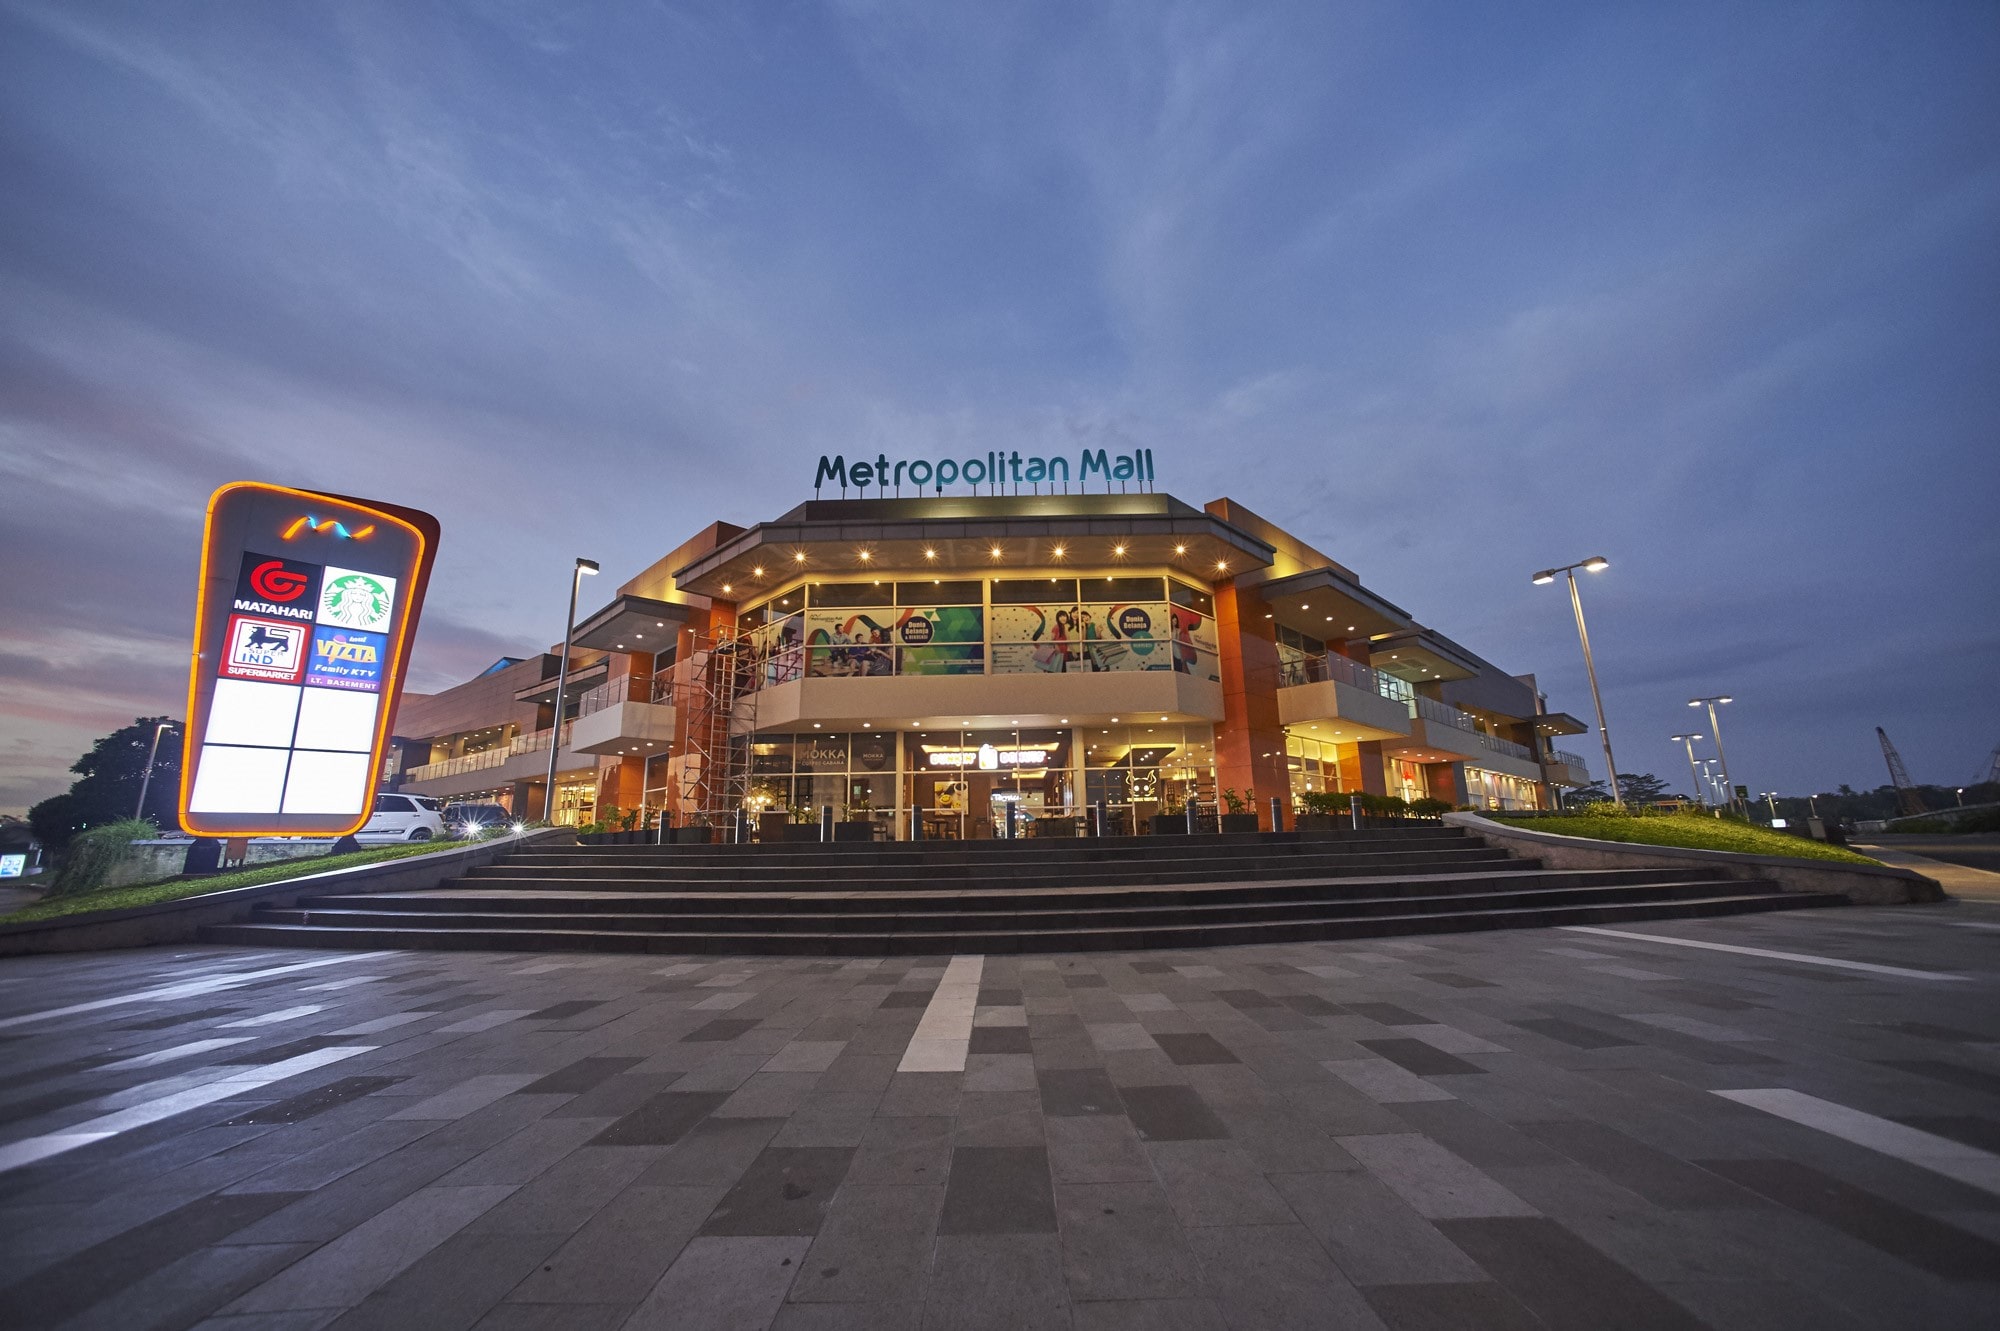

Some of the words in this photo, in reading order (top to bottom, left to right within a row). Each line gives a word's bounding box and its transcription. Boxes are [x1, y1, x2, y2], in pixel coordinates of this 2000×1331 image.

[814, 451, 1069, 492] Metropolitan
[1080, 448, 1154, 481] Mall
[234, 600, 313, 620] MATAHARI
[248, 648, 284, 657] SUPER
[228, 667, 297, 681] SUPERMARKET
[315, 664, 350, 676] Family
[350, 667, 376, 678] KTV
[310, 677, 323, 685] LT.
[327, 679, 376, 690] BASEMENT
[801, 749, 846, 759] MOKKA
